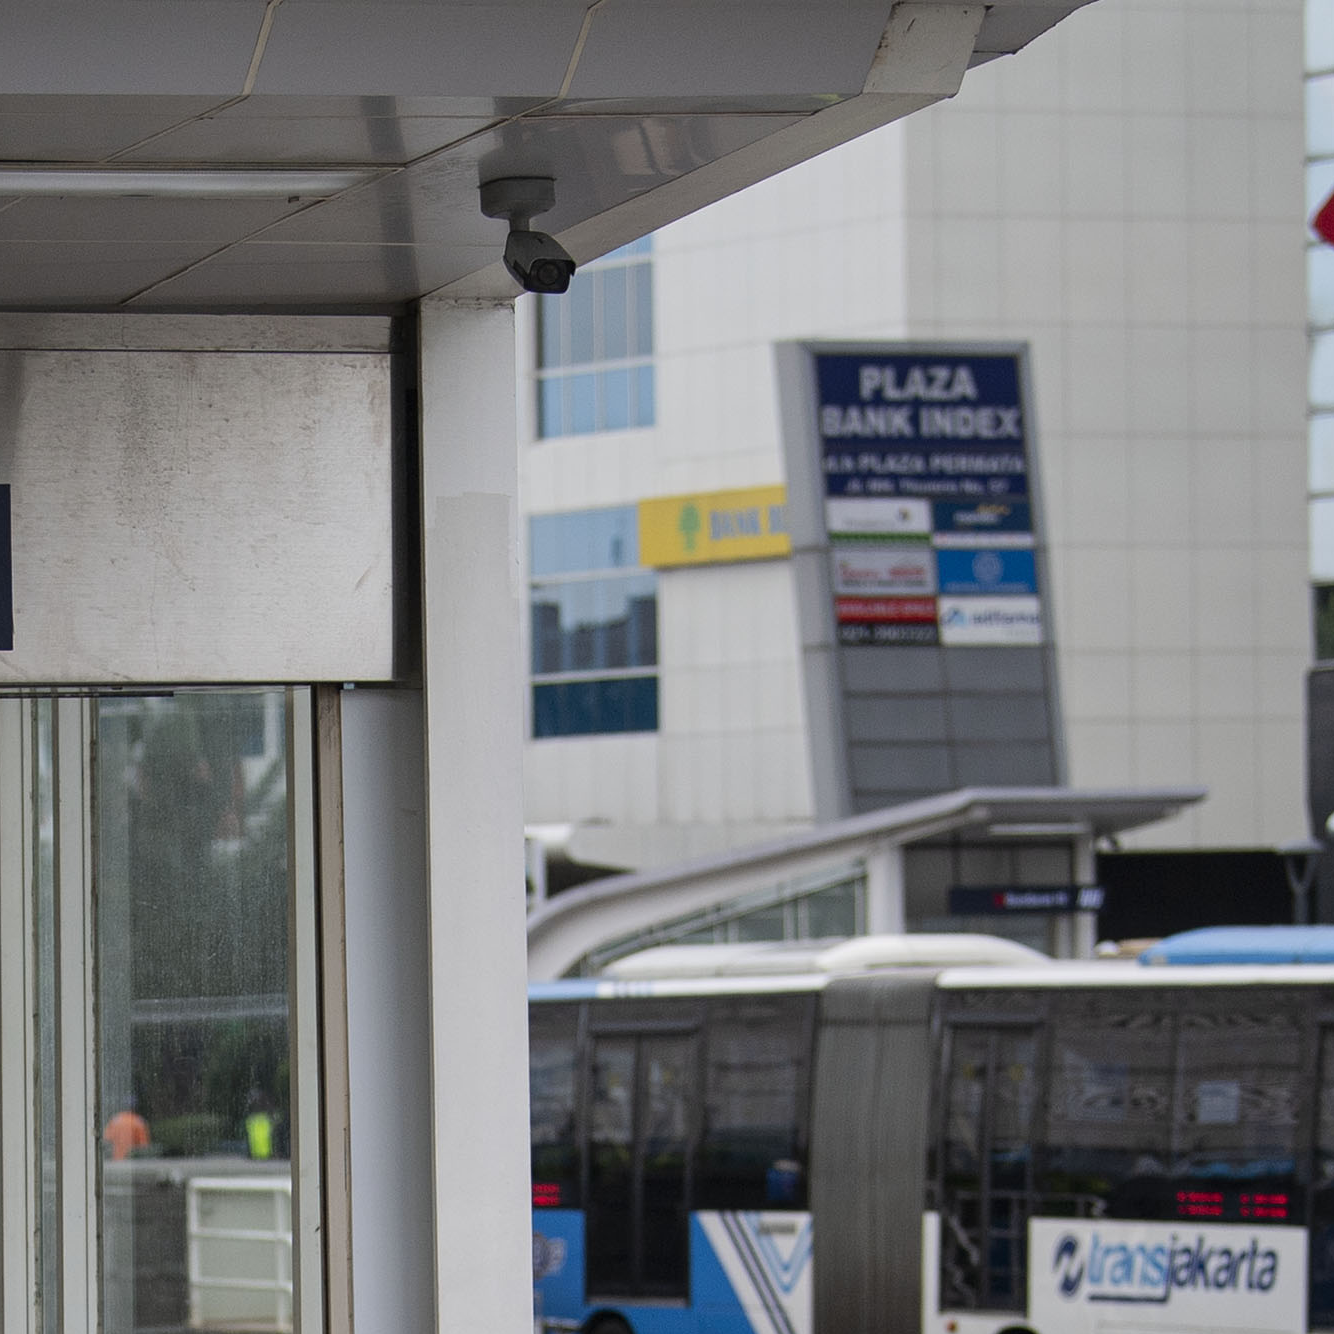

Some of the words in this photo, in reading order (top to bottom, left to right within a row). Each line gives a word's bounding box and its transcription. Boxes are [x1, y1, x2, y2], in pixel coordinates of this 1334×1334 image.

[859, 365, 978, 401] PLAZA
[821, 404, 914, 437] BANK
[920, 405, 1020, 439] INDEX
[1088, 1231, 1280, 1303] transjakarta
